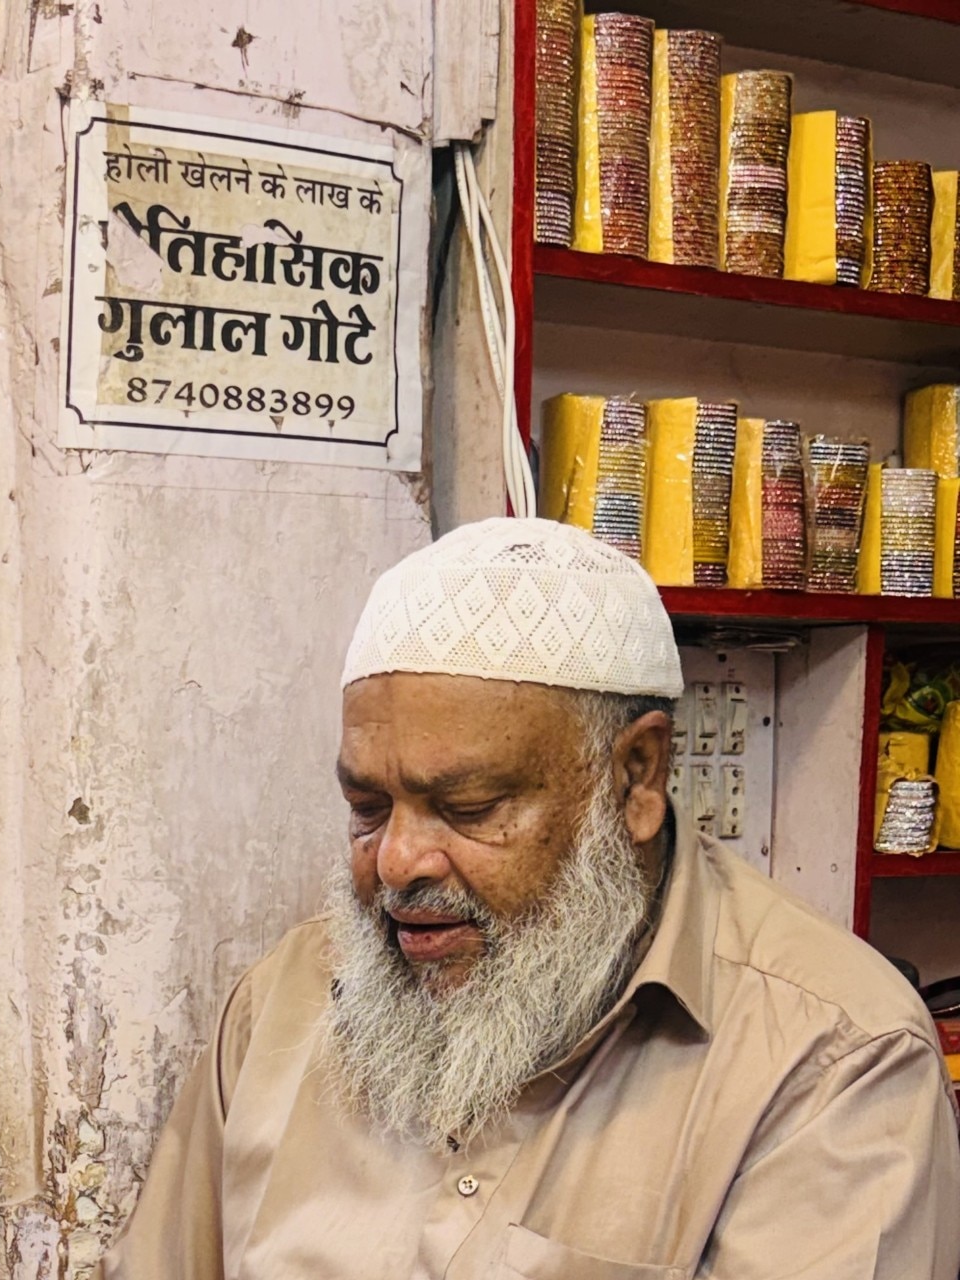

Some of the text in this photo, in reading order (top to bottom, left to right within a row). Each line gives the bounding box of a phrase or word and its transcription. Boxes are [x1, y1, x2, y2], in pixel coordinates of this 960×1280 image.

[178, 153, 252, 193] खेलने
[258, 164, 287, 199] के
[293, 177, 352, 209] लाख
[357, 180, 383, 214] के
[94, 296, 376, 365] गुलाल गोटे
[127, 377, 355, 420] 8740883899
